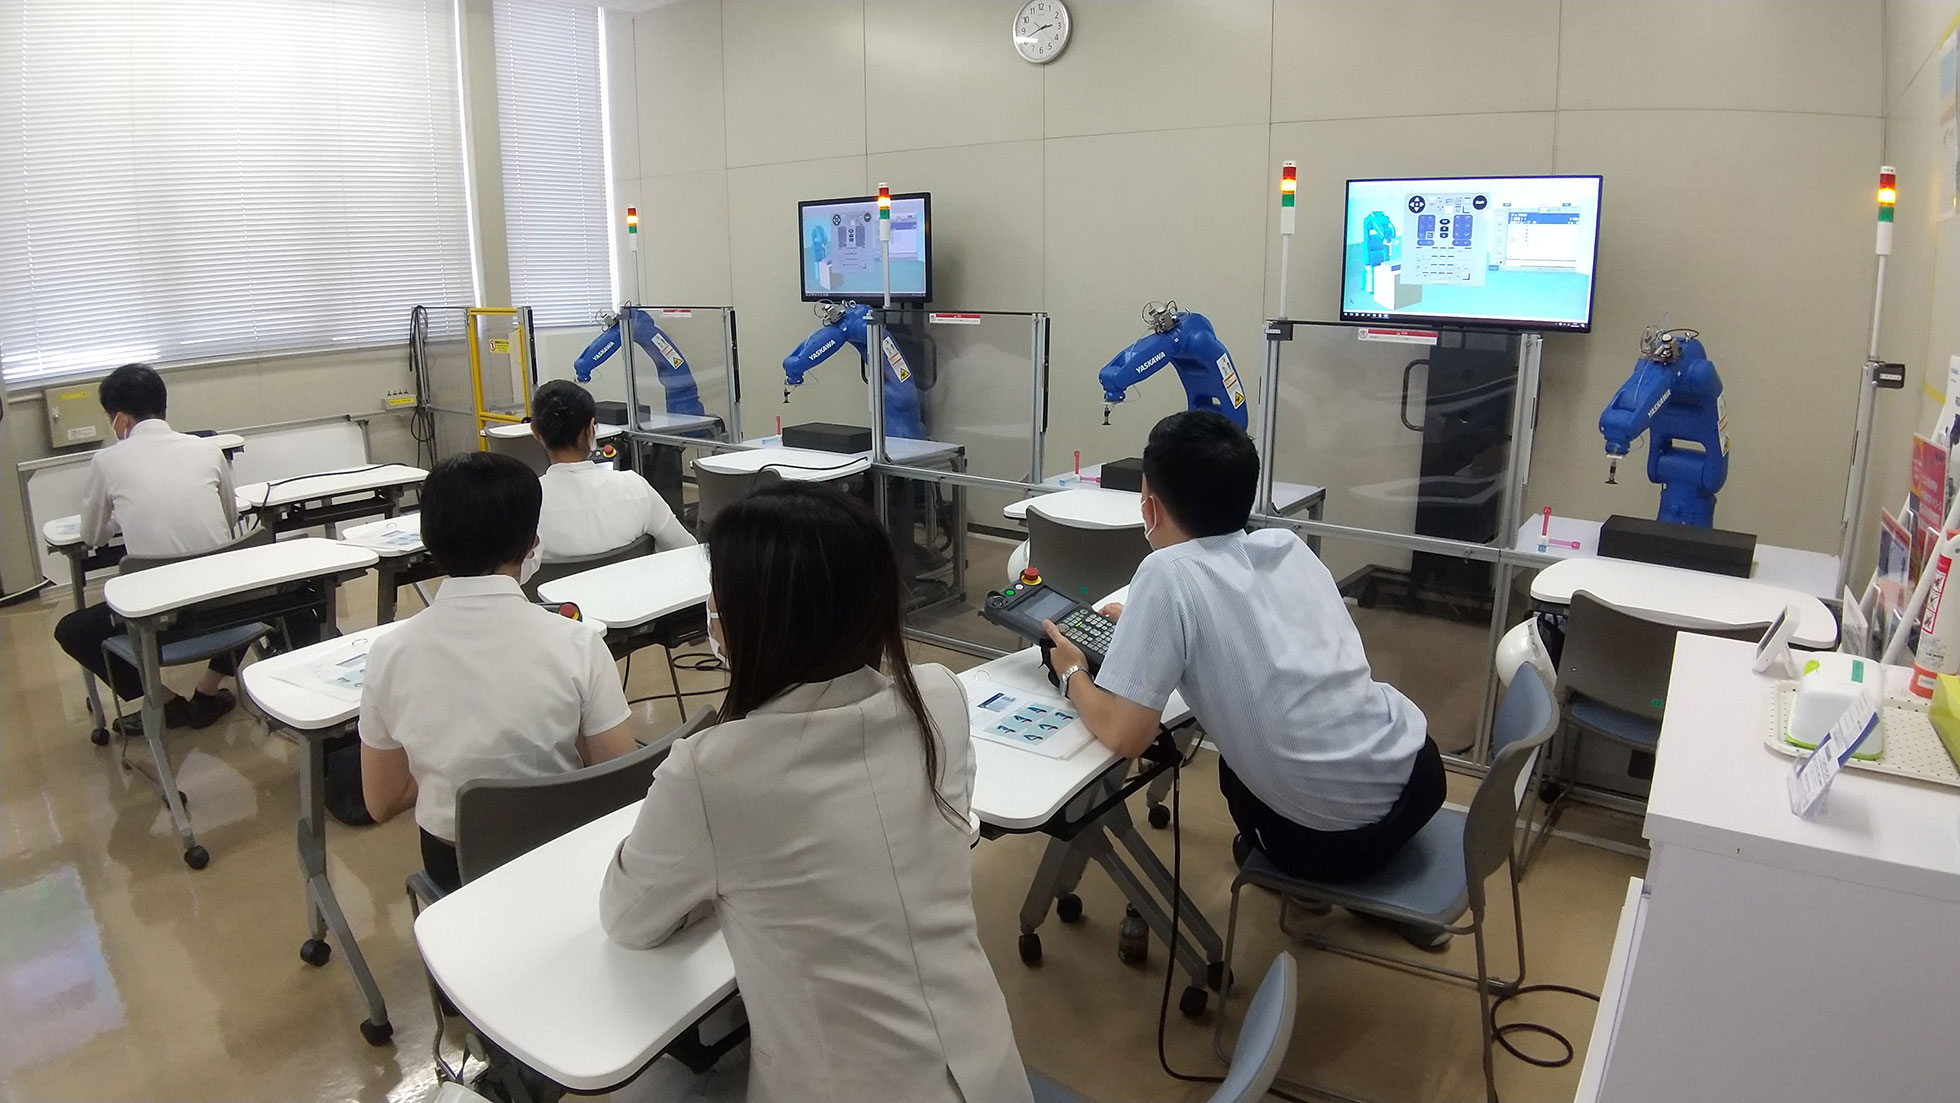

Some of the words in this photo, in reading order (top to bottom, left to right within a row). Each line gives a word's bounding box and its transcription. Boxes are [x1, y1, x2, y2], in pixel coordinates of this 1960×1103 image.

[1030, 7, 1036, 15] 11
[1038, 3, 1045, 11] 12
[1054, 11, 1059, 19] 2
[1048, 42, 1052, 50] 5
[592, 341, 615, 361] YASKAWA
[808, 340, 836, 361] YASKAWA
[1136, 351, 1166, 374] YASKAWA
